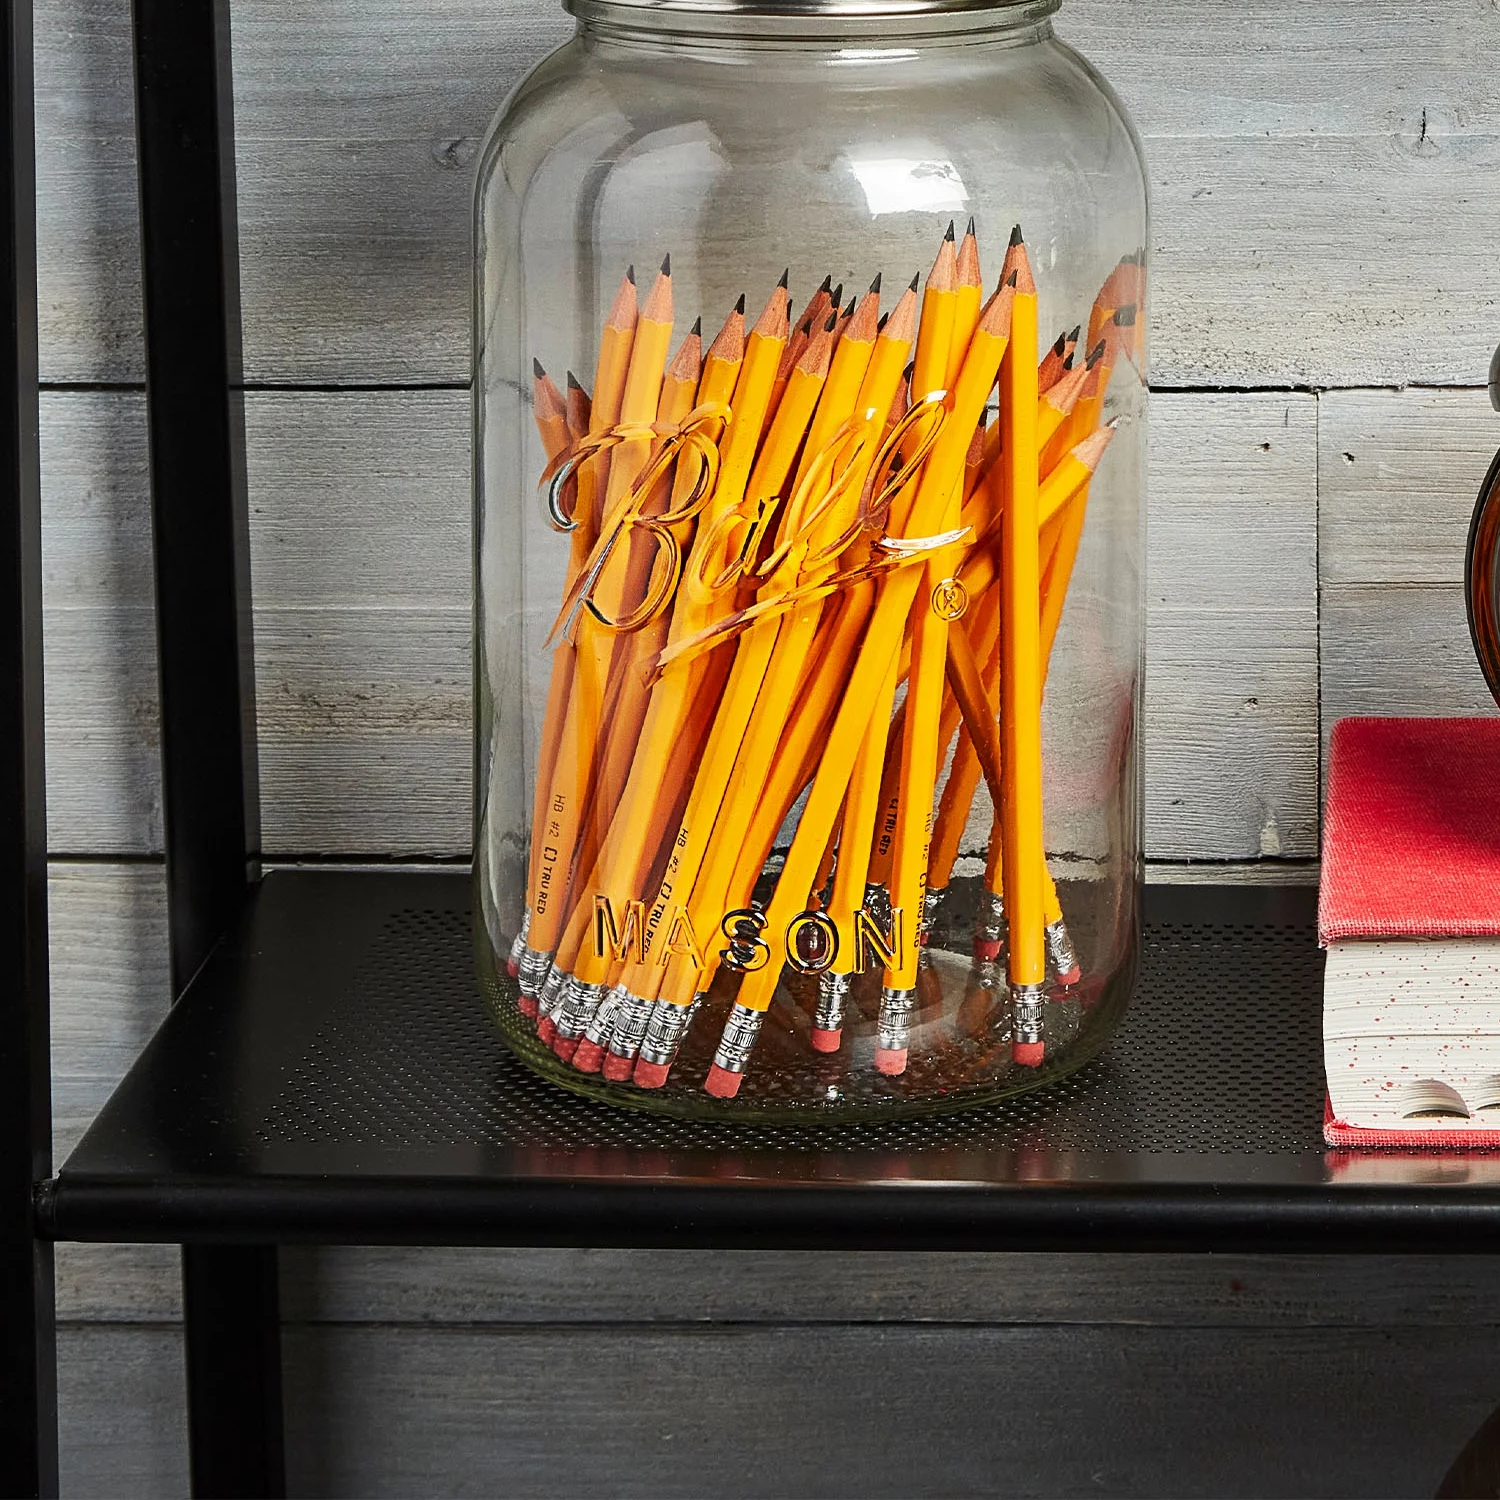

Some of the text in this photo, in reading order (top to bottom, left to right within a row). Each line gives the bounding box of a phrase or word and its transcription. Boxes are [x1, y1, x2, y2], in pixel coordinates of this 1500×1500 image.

[553, 794, 566, 813] HB
[677, 828, 689, 848] HB
[541, 866, 552, 889] TRU
[537, 892, 548, 914] RED
[648, 903, 665, 932] TRU
[593, 893, 904, 975] MASON
